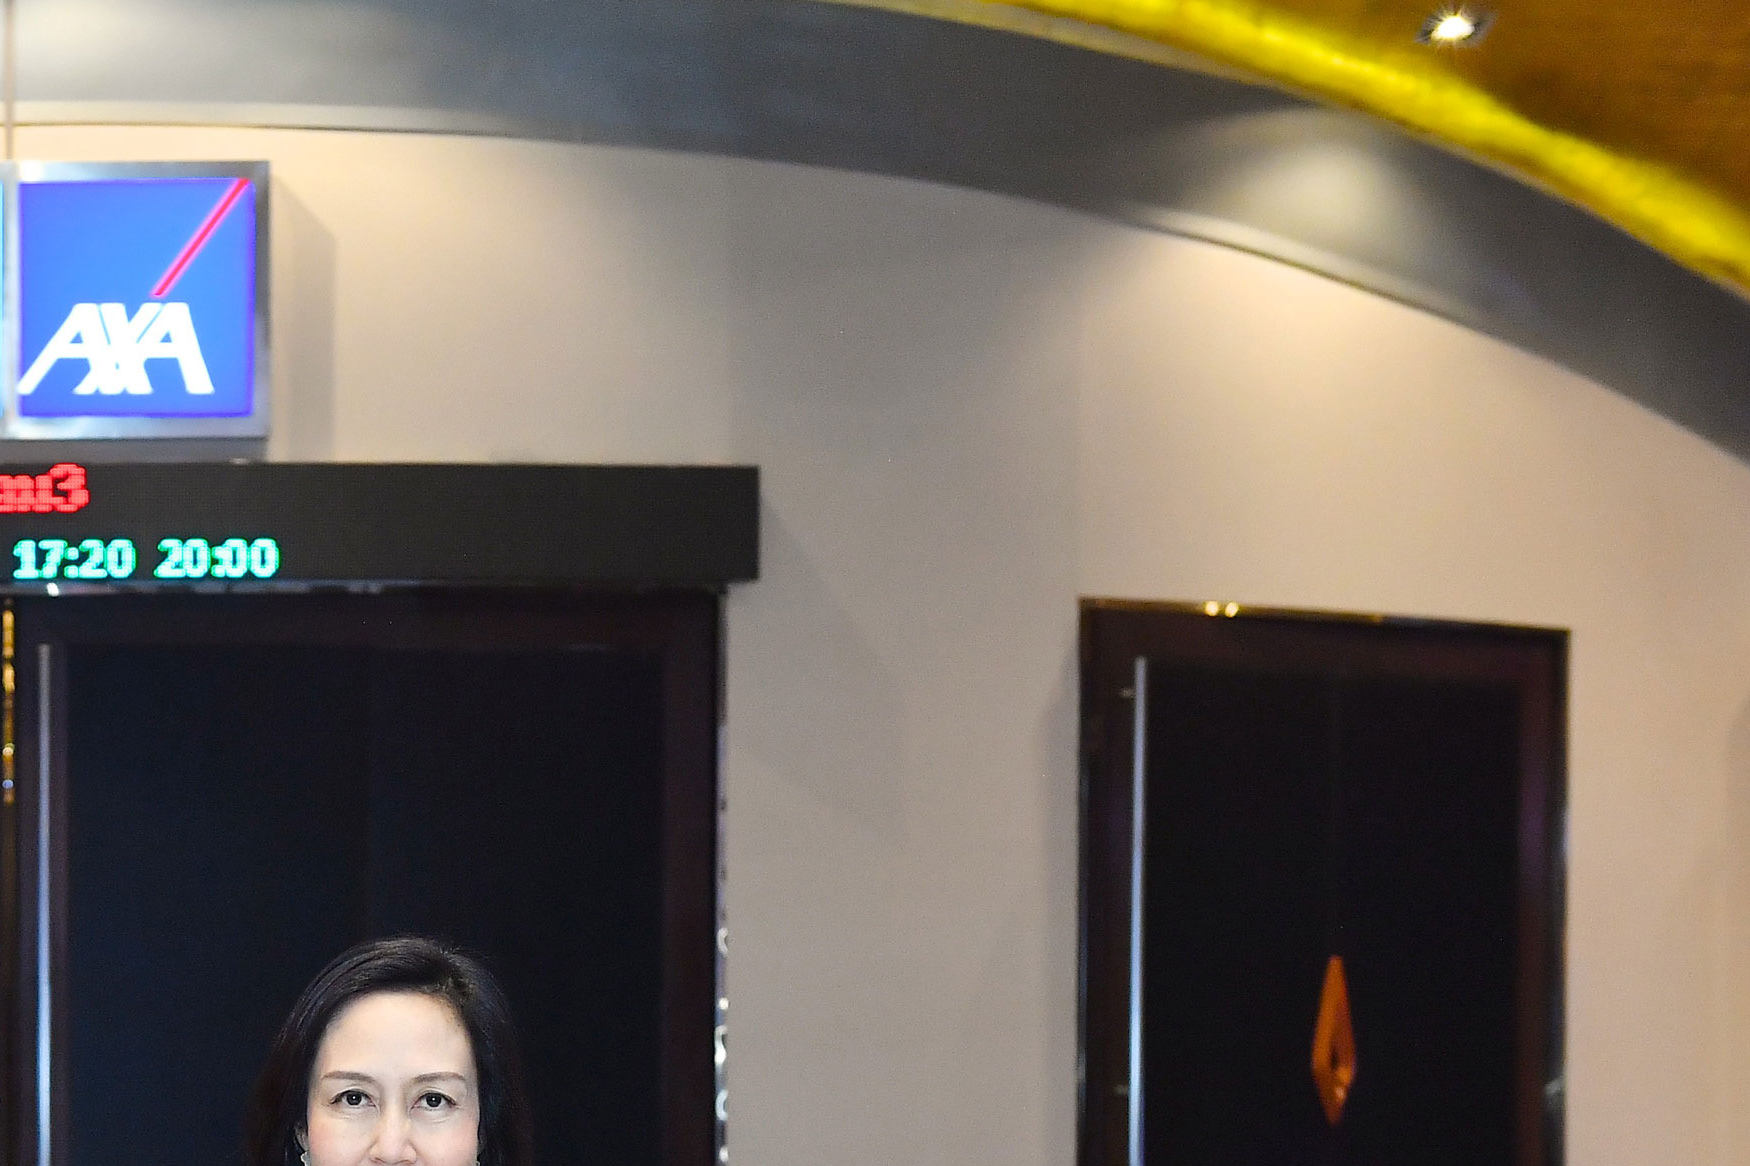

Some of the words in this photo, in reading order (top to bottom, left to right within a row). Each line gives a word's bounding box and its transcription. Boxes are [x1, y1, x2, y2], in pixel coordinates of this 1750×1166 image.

[18, 302, 215, 394] AXA
[12, 538, 137, 581] 17:20
[153, 537, 280, 580] 20:00
